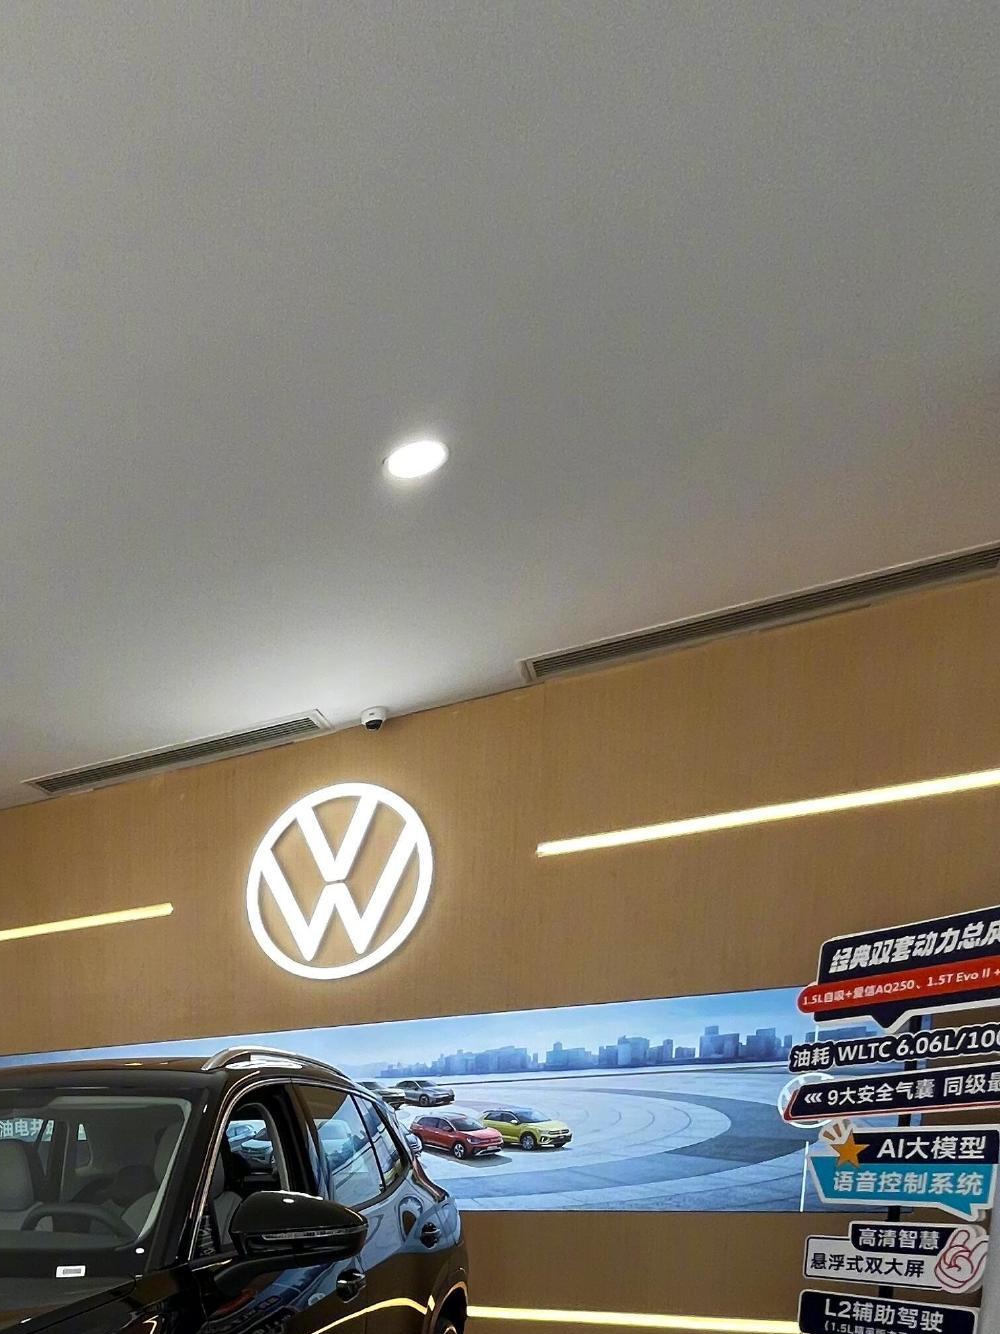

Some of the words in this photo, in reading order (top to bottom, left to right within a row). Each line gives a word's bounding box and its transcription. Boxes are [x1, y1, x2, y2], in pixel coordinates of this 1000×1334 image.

[249, 785, 430, 966] VW
[956, 971, 979, 983] Evo
[793, 1046, 830, 1068] 油耗
[838, 1041, 892, 1062] WLTC
[827, 1079, 936, 1106] 9大安全气囊
[876, 1135, 987, 1160] AI大模型
[832, 1170, 985, 1197] 语音控制系统
[858, 1227, 940, 1251] 高清智慧
[810, 1252, 926, 1279] 悬浮式双大屏
[824, 1298, 944, 1333] L2辅助驾驶
